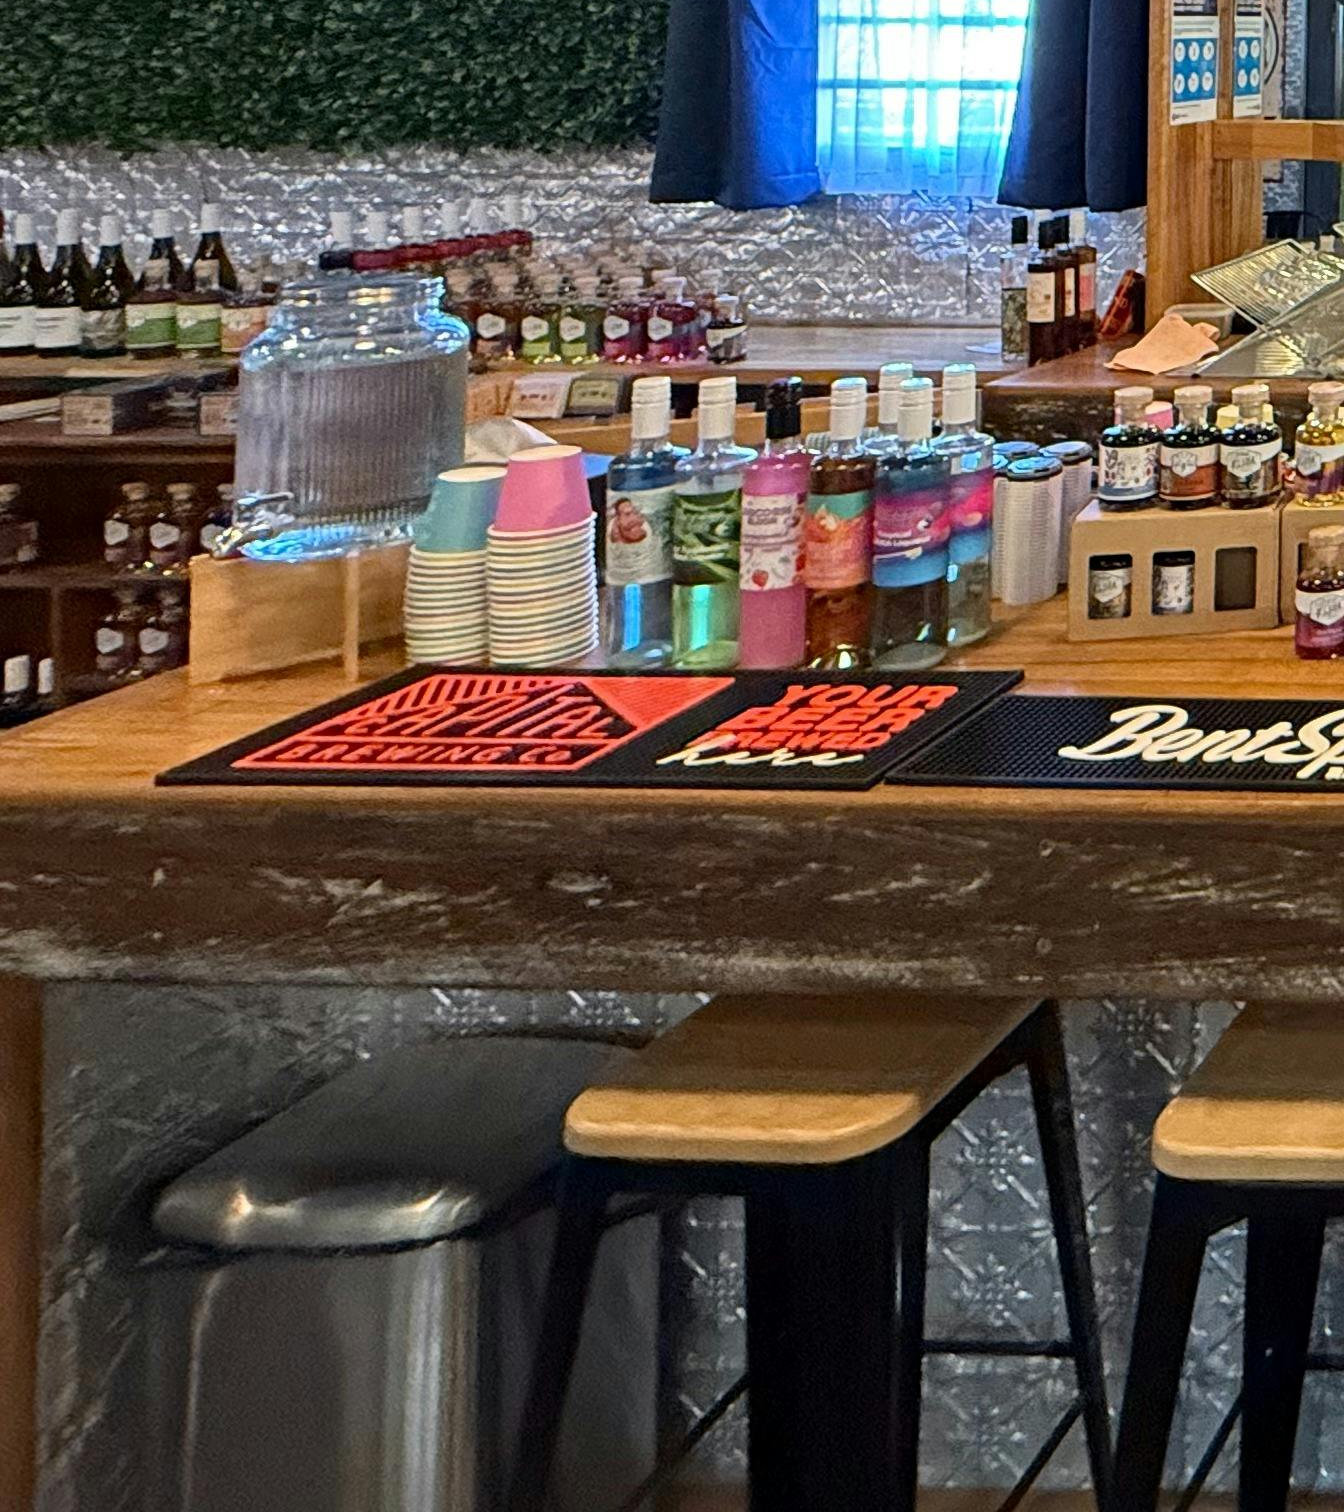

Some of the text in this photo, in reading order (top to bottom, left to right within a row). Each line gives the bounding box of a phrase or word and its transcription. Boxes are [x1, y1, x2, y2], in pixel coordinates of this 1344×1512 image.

[773, 685, 959, 709] YOUR
[345, 682, 615, 738] CAPITAL
[715, 707, 926, 732] BEER
[275, 742, 511, 763] BREWING
[656, 734, 865, 767] here
